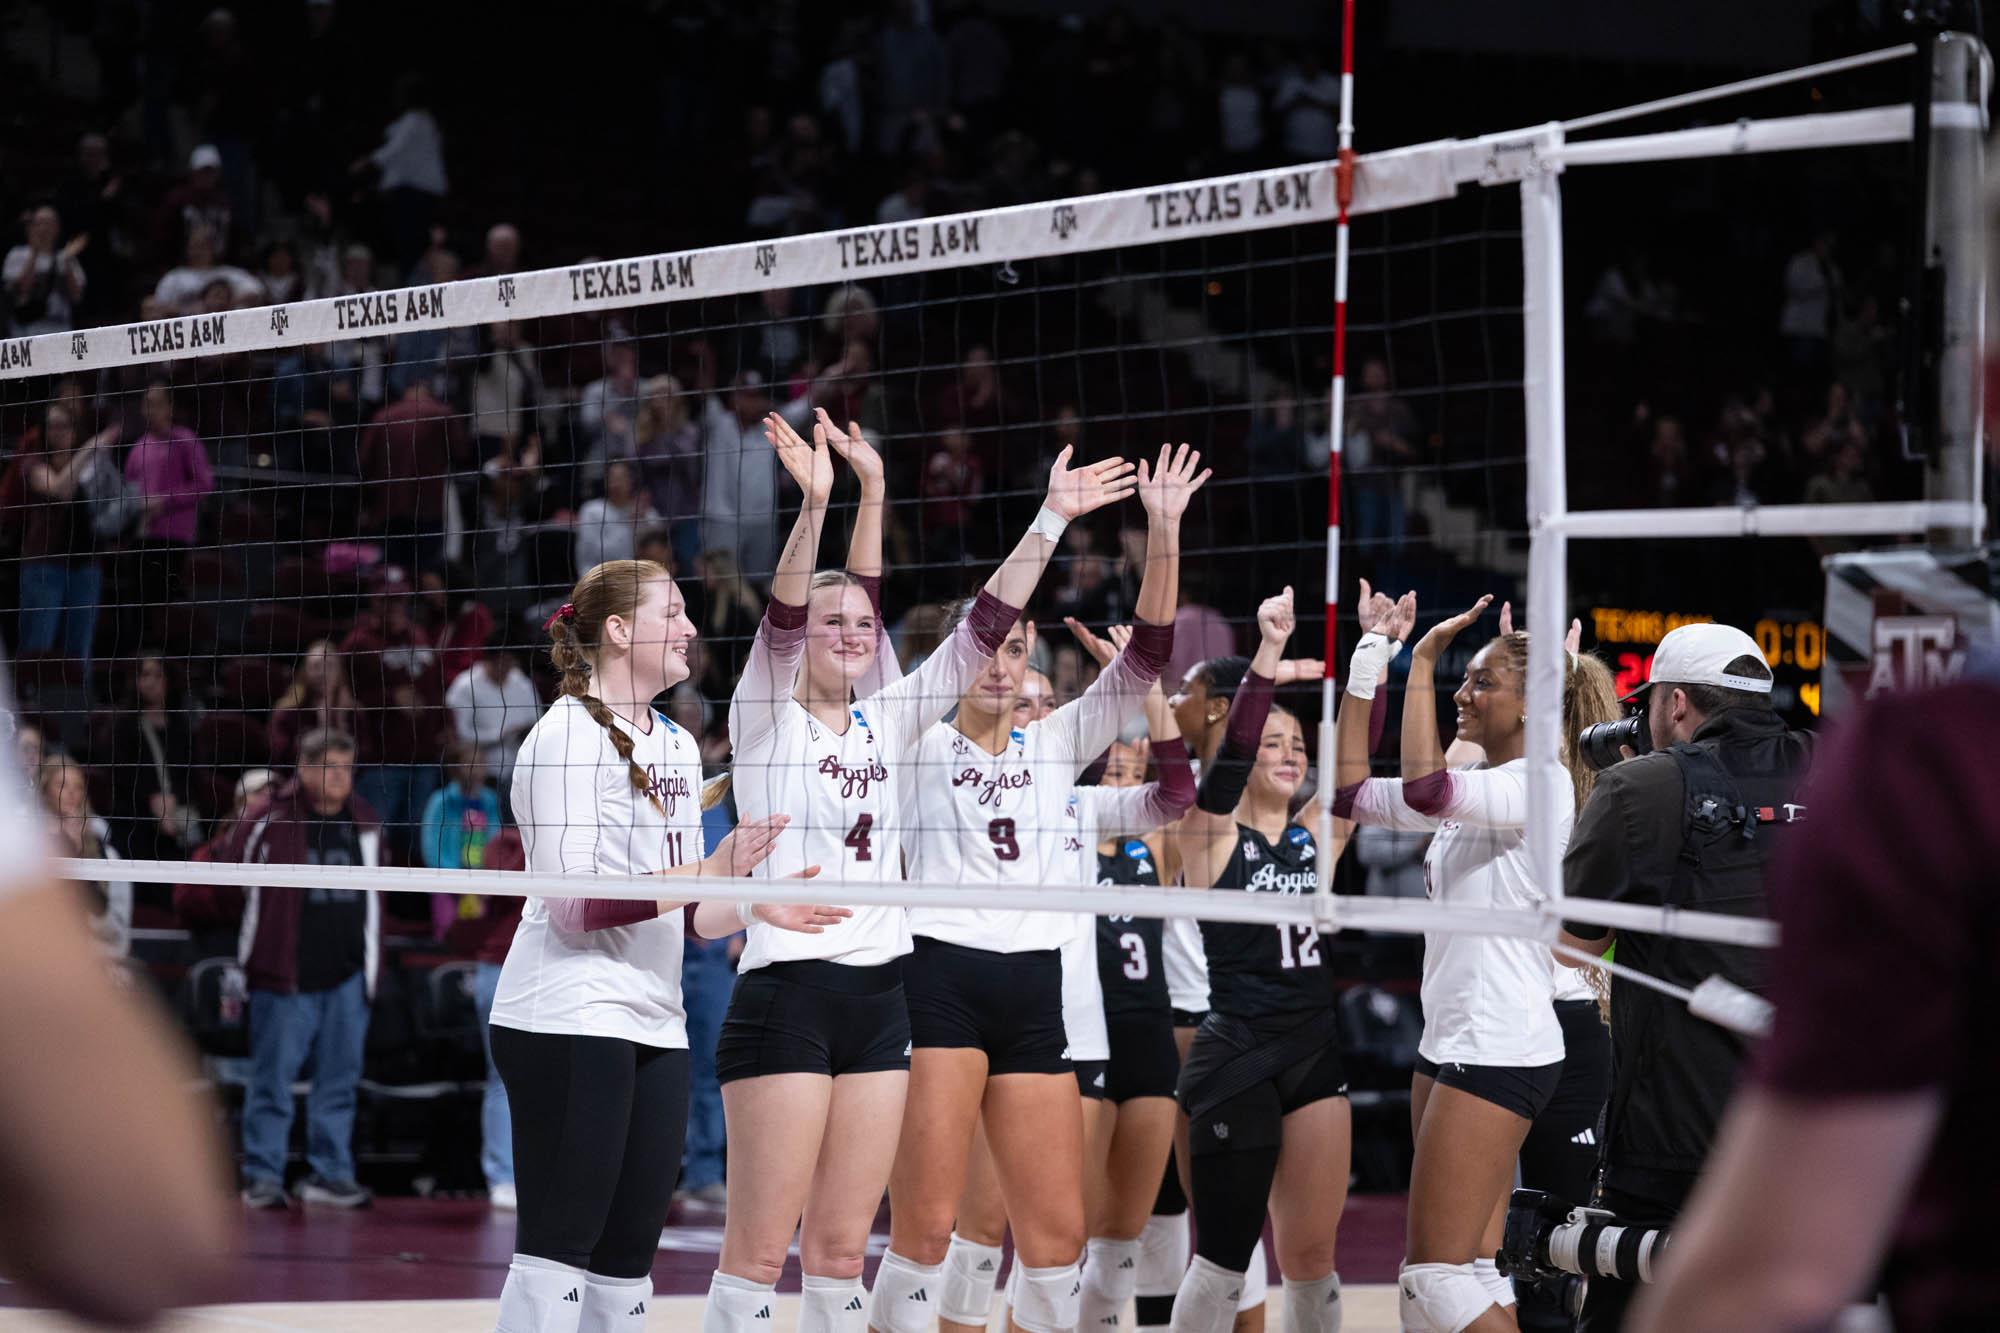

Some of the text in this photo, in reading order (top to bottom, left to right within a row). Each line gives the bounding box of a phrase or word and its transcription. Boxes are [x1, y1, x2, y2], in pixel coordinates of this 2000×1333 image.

[1146, 172, 1311, 229] TEXAS A&M
[837, 218, 979, 268] TEXAS A&M
[570, 255, 695, 300] TEXAS A&M
[334, 287, 445, 330] TEXAS A&M
[0, 339, 32, 370] A&M
[128, 315, 225, 355] TEXAS A&M
[643, 763, 690, 817] Aggies
[667, 832, 683, 867] 11
[845, 813, 873, 861] 4
[988, 817, 1020, 861] 9
[1245, 863, 1319, 896] Aggie
[1120, 933, 1149, 980] 3
[1276, 922, 1321, 969] 12
